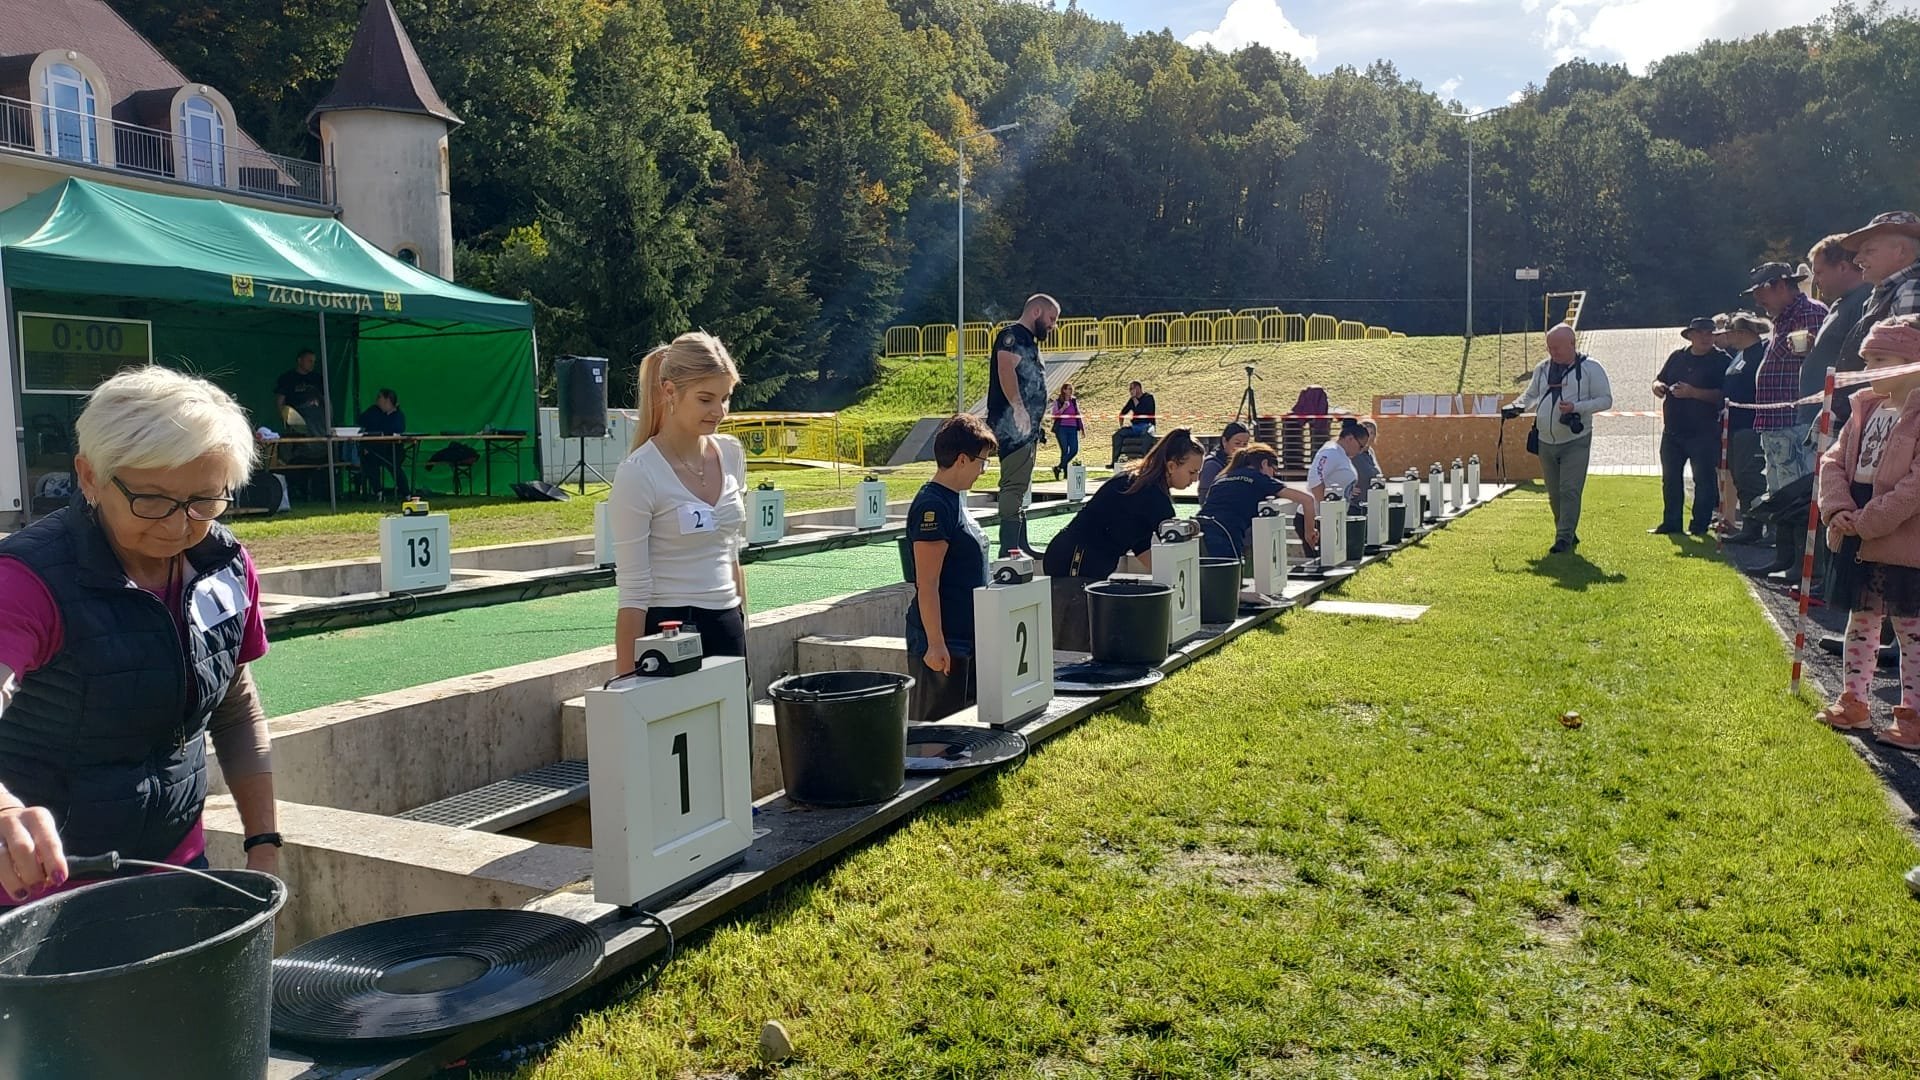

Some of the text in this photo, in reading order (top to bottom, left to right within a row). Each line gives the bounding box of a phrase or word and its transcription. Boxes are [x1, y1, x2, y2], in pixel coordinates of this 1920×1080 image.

[267, 284, 373, 313] ZŁOTORYJA
[52, 322, 124, 351] 0:00
[692, 510, 704, 529] 2
[762, 505, 774, 527] 15
[868, 495, 878, 514] 16
[407, 536, 431, 568] 13
[1272, 538, 1278, 569] 4
[206, 587, 230, 617] 1
[1178, 569, 1186, 610] 3
[1015, 621, 1028, 677] 2
[671, 732, 691, 816] 1
